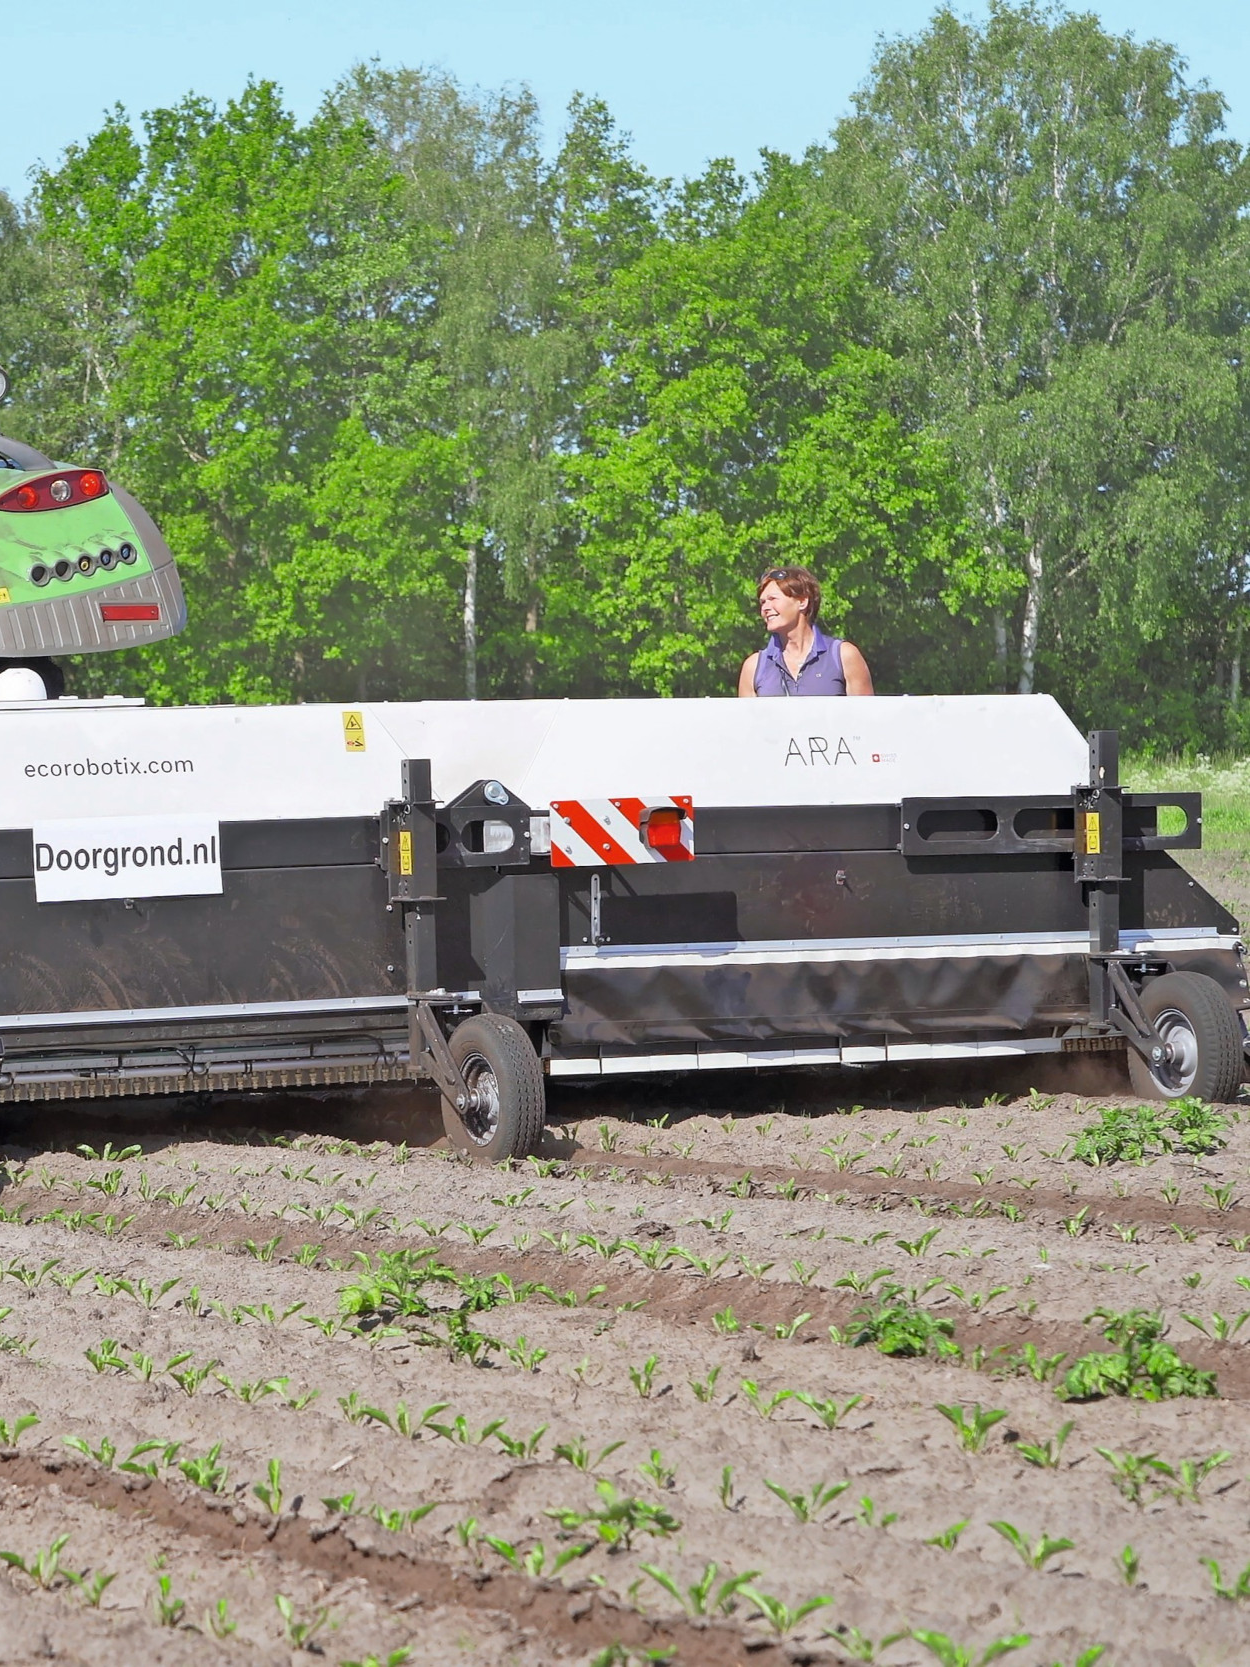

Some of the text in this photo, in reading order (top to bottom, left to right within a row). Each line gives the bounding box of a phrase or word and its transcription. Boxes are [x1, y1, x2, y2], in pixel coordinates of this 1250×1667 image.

[784, 736, 857, 767] ARA
[24, 757, 194, 778] ecorobotix.com
[35, 835, 217, 877] Doorgrond.nl
